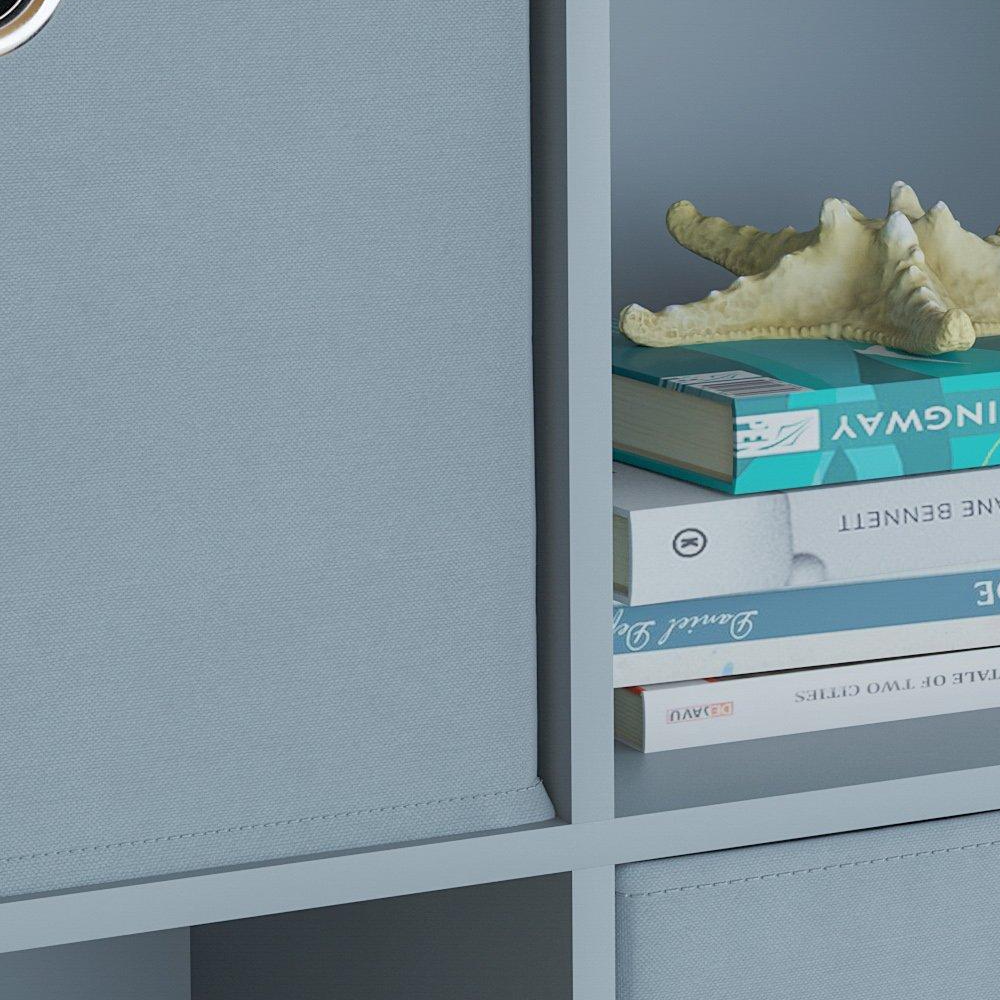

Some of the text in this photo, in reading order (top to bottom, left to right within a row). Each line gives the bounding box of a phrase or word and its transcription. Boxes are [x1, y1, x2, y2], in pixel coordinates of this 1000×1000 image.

[838, 501, 953, 532] BENNETT
[657, 609, 758, 645] Daniel
[867, 678, 915, 695] TWO
[922, 674, 946, 688] OF
[795, 685, 860, 703] CITIES
